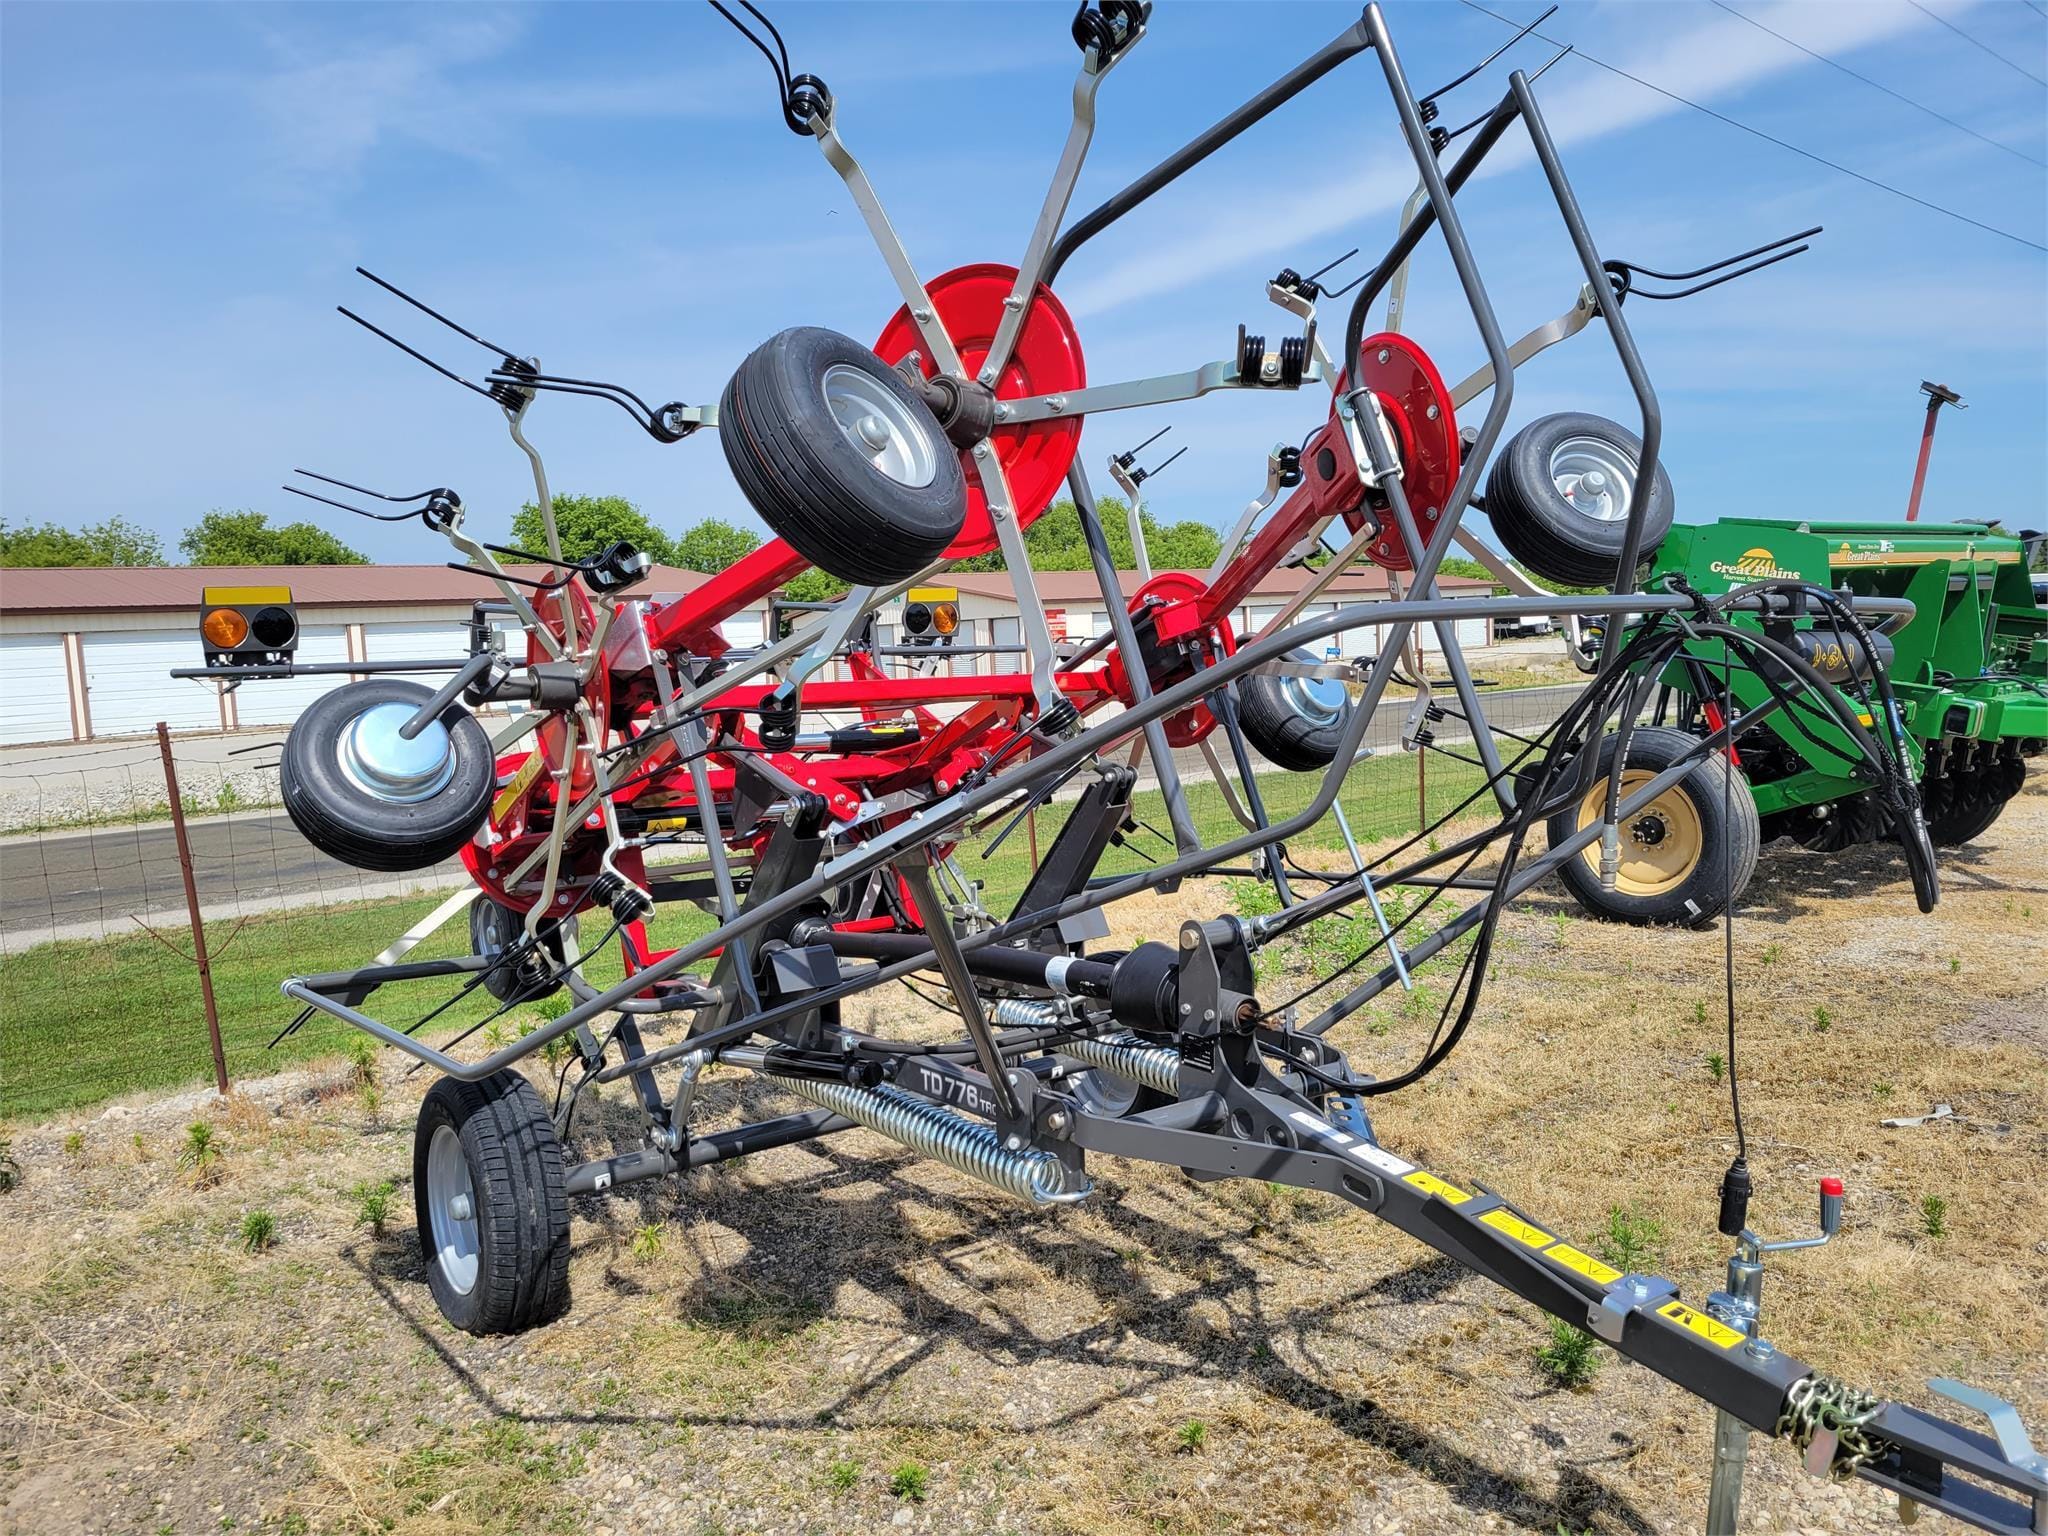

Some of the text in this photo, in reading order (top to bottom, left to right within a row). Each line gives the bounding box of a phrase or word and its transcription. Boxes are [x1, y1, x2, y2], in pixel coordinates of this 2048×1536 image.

[1710, 561, 1801, 580] Great Plains
[920, 1067, 943, 1096] TD
[944, 1076, 978, 1109] 776
